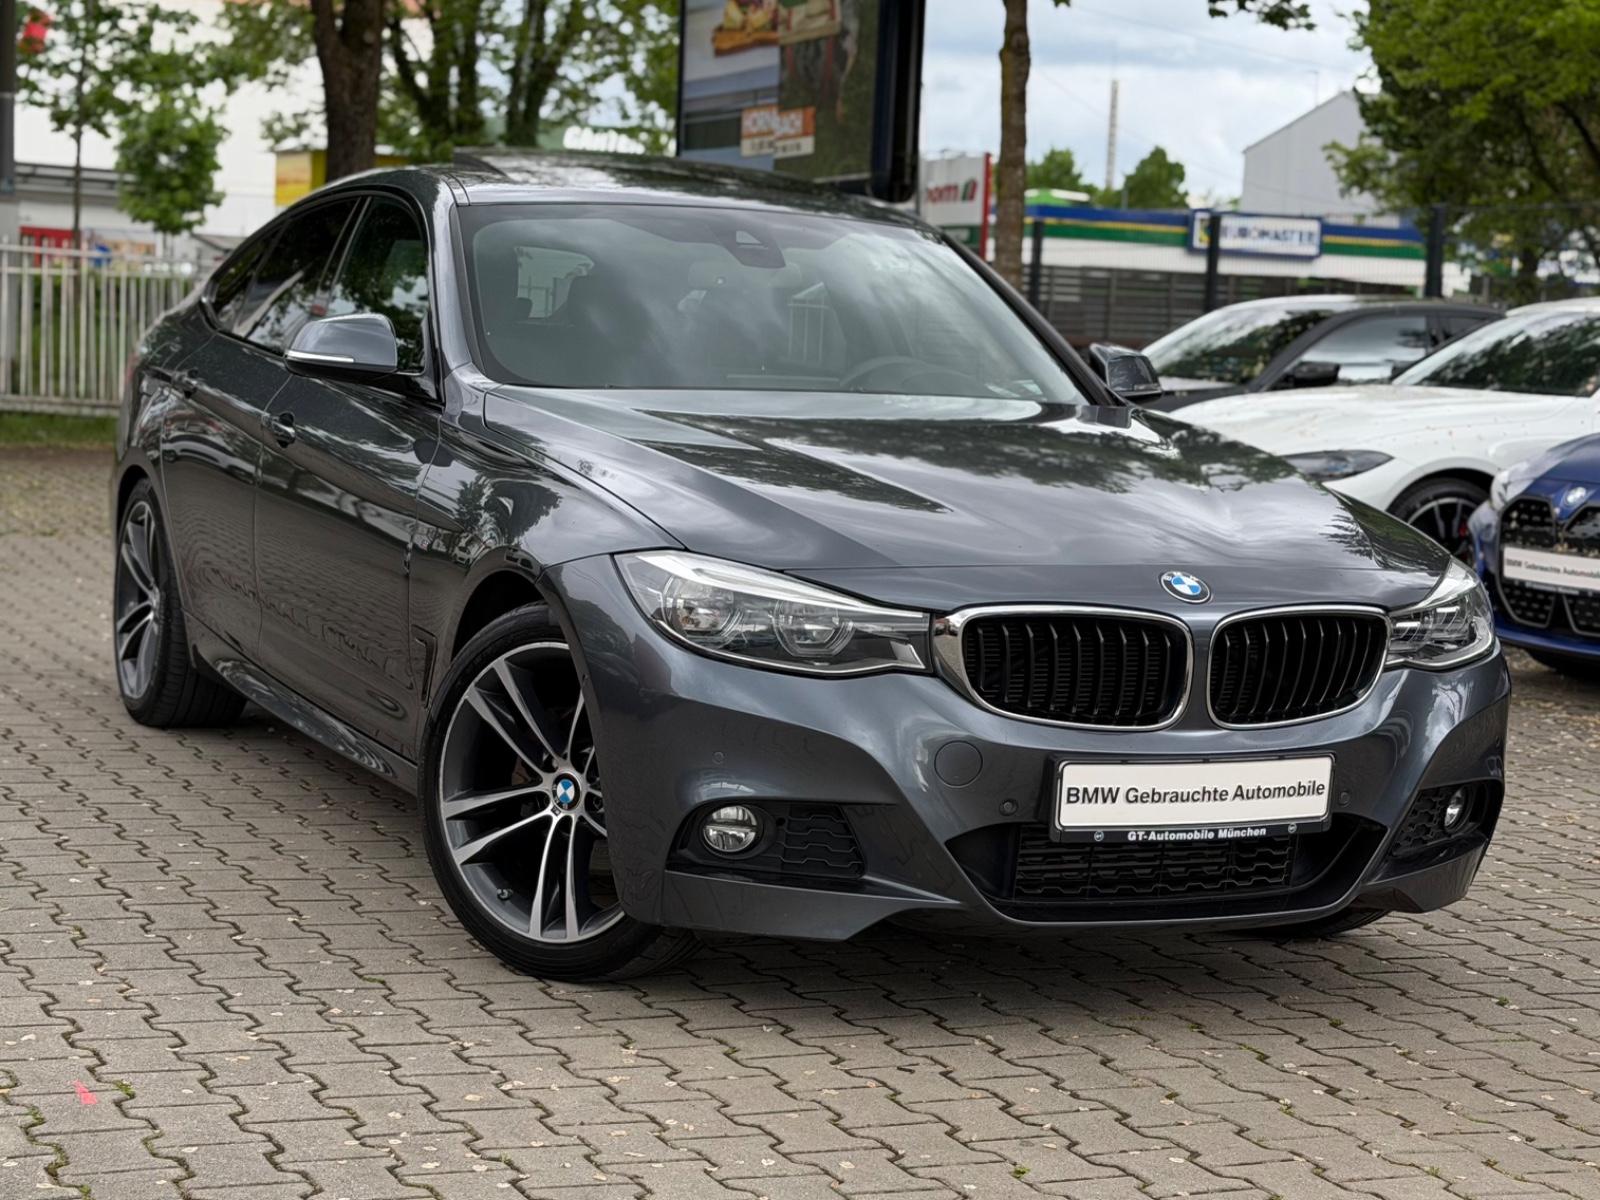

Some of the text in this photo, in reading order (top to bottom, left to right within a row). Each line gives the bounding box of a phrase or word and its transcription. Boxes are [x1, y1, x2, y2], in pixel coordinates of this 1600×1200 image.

[1065, 780, 1326, 805] BMW Gebrauchte Automobile
[1127, 826, 1267, 842] GT-Automobile München
